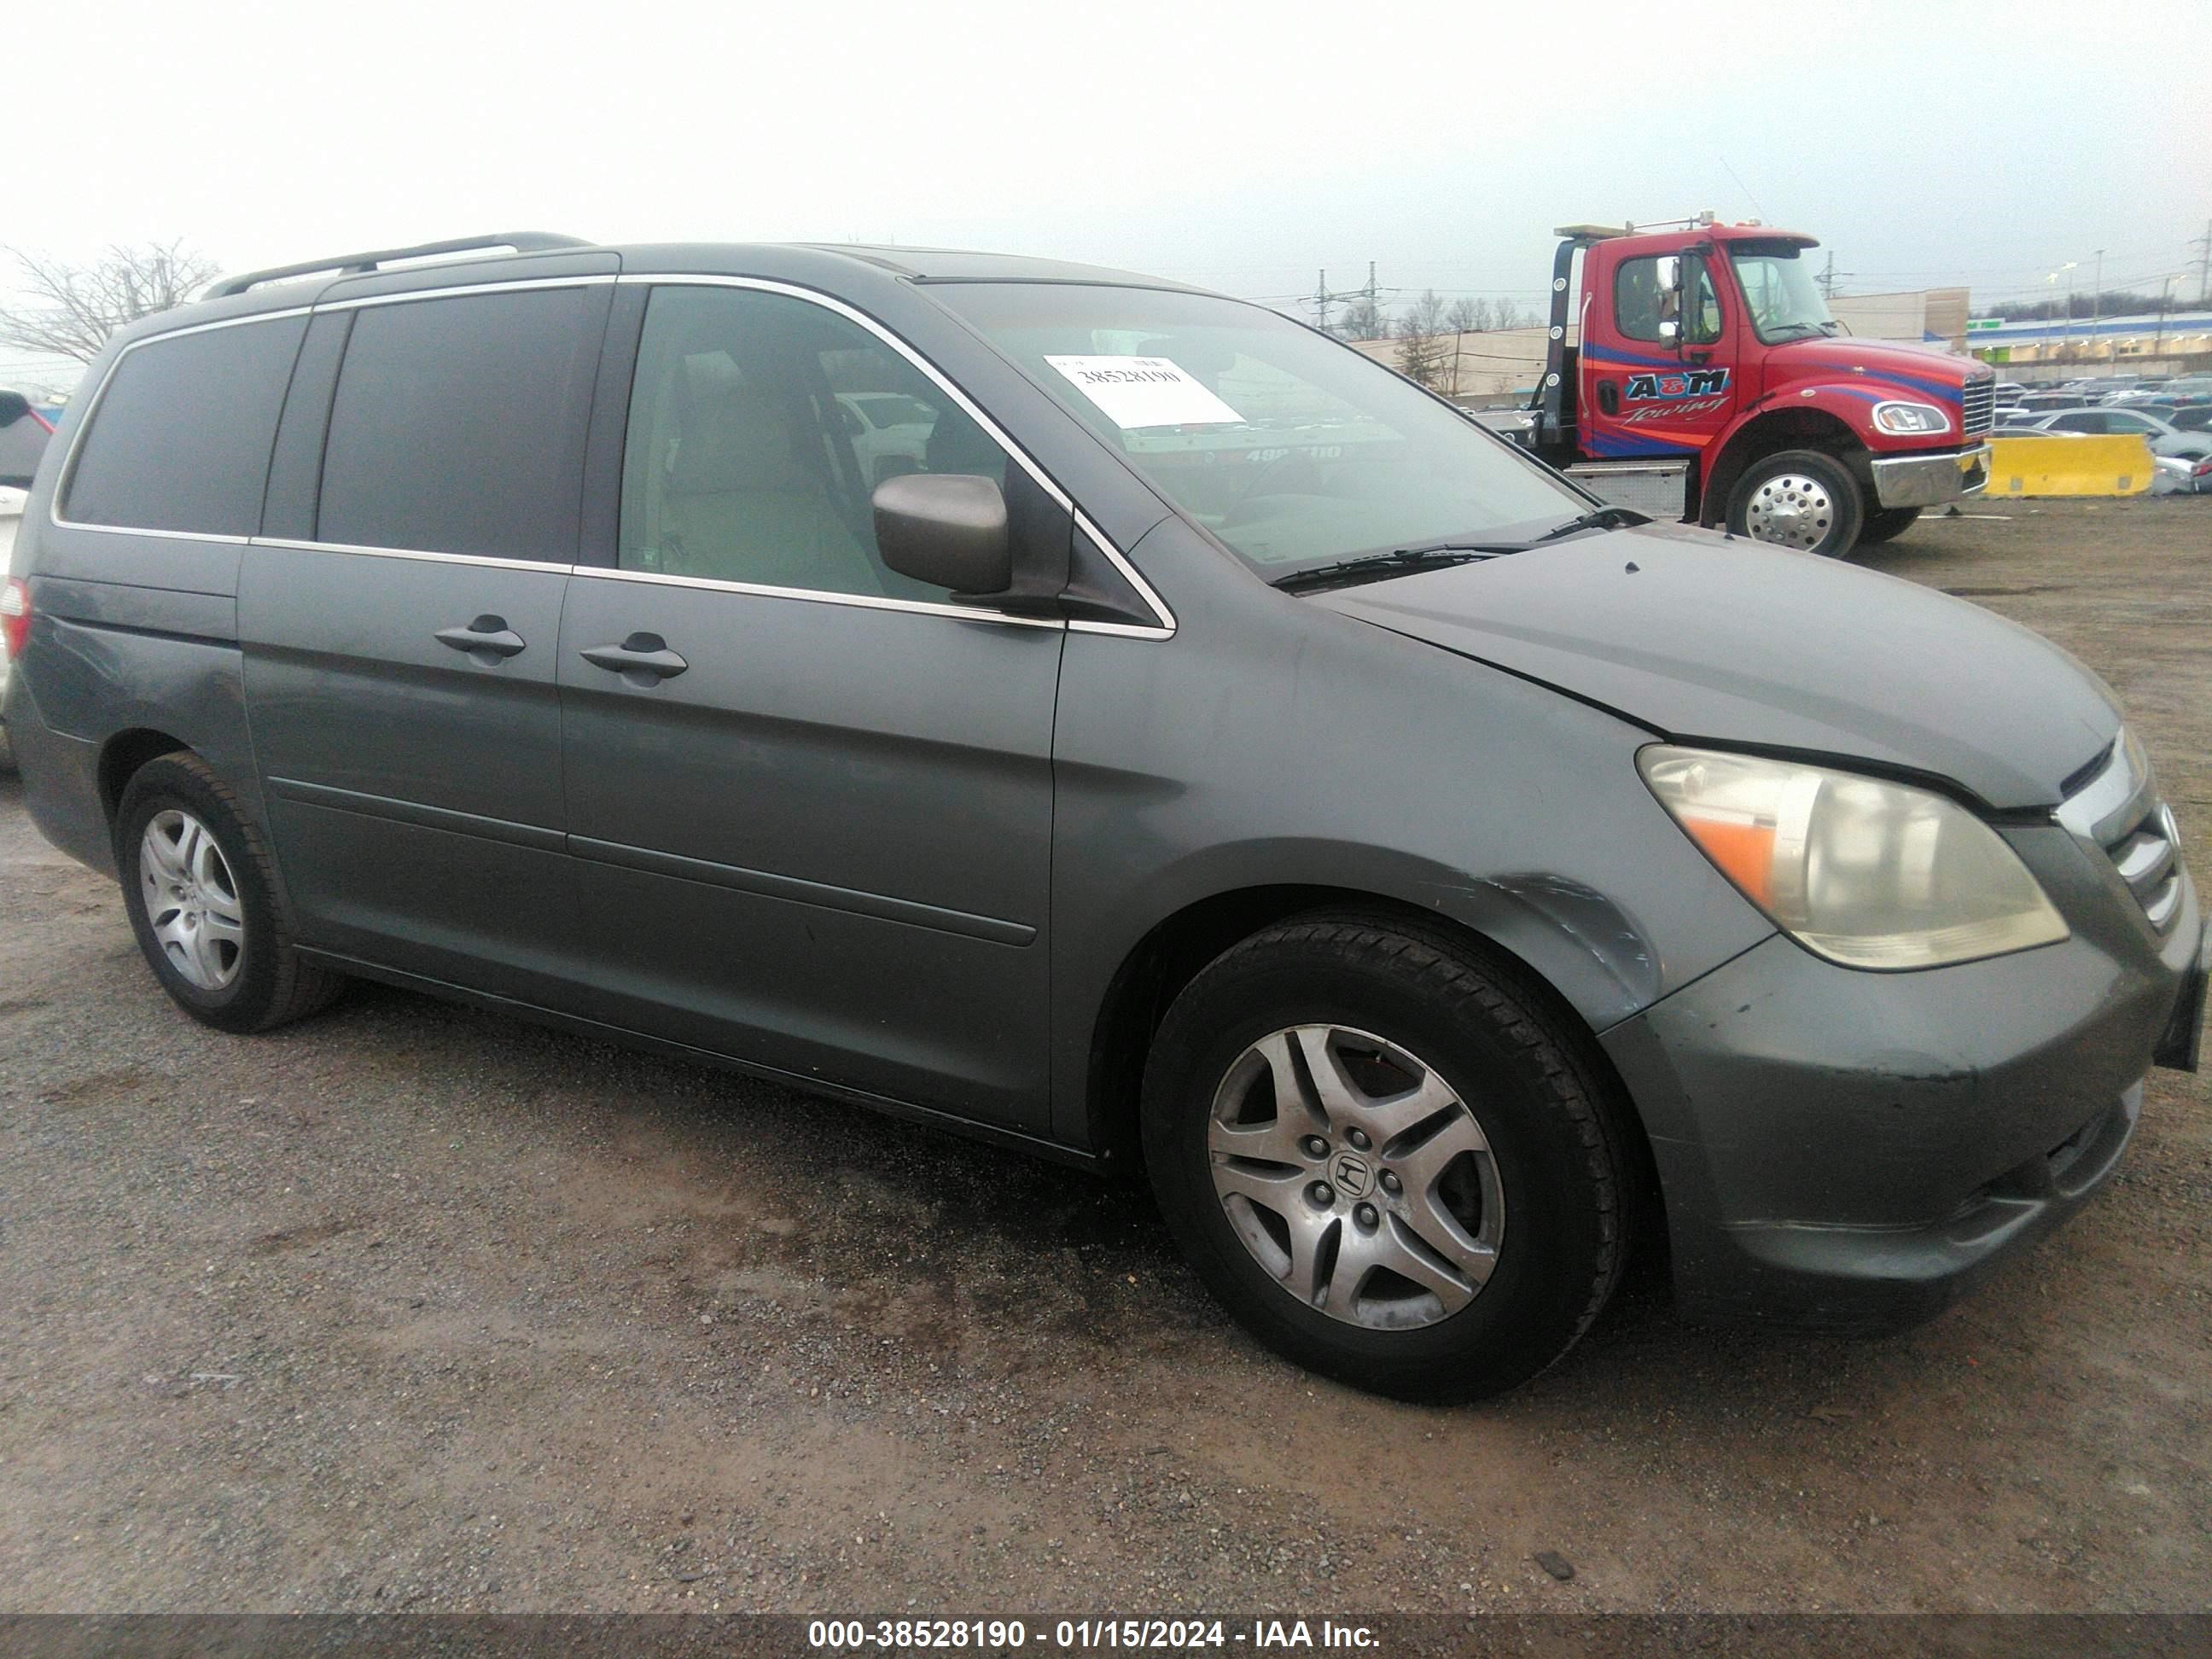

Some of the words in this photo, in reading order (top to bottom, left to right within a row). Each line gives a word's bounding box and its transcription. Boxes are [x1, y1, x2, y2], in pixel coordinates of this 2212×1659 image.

[1077, 370, 1181, 384] 38528190
[1626, 368, 1730, 401] A&M
[1620, 396, 1731, 427] Towing
